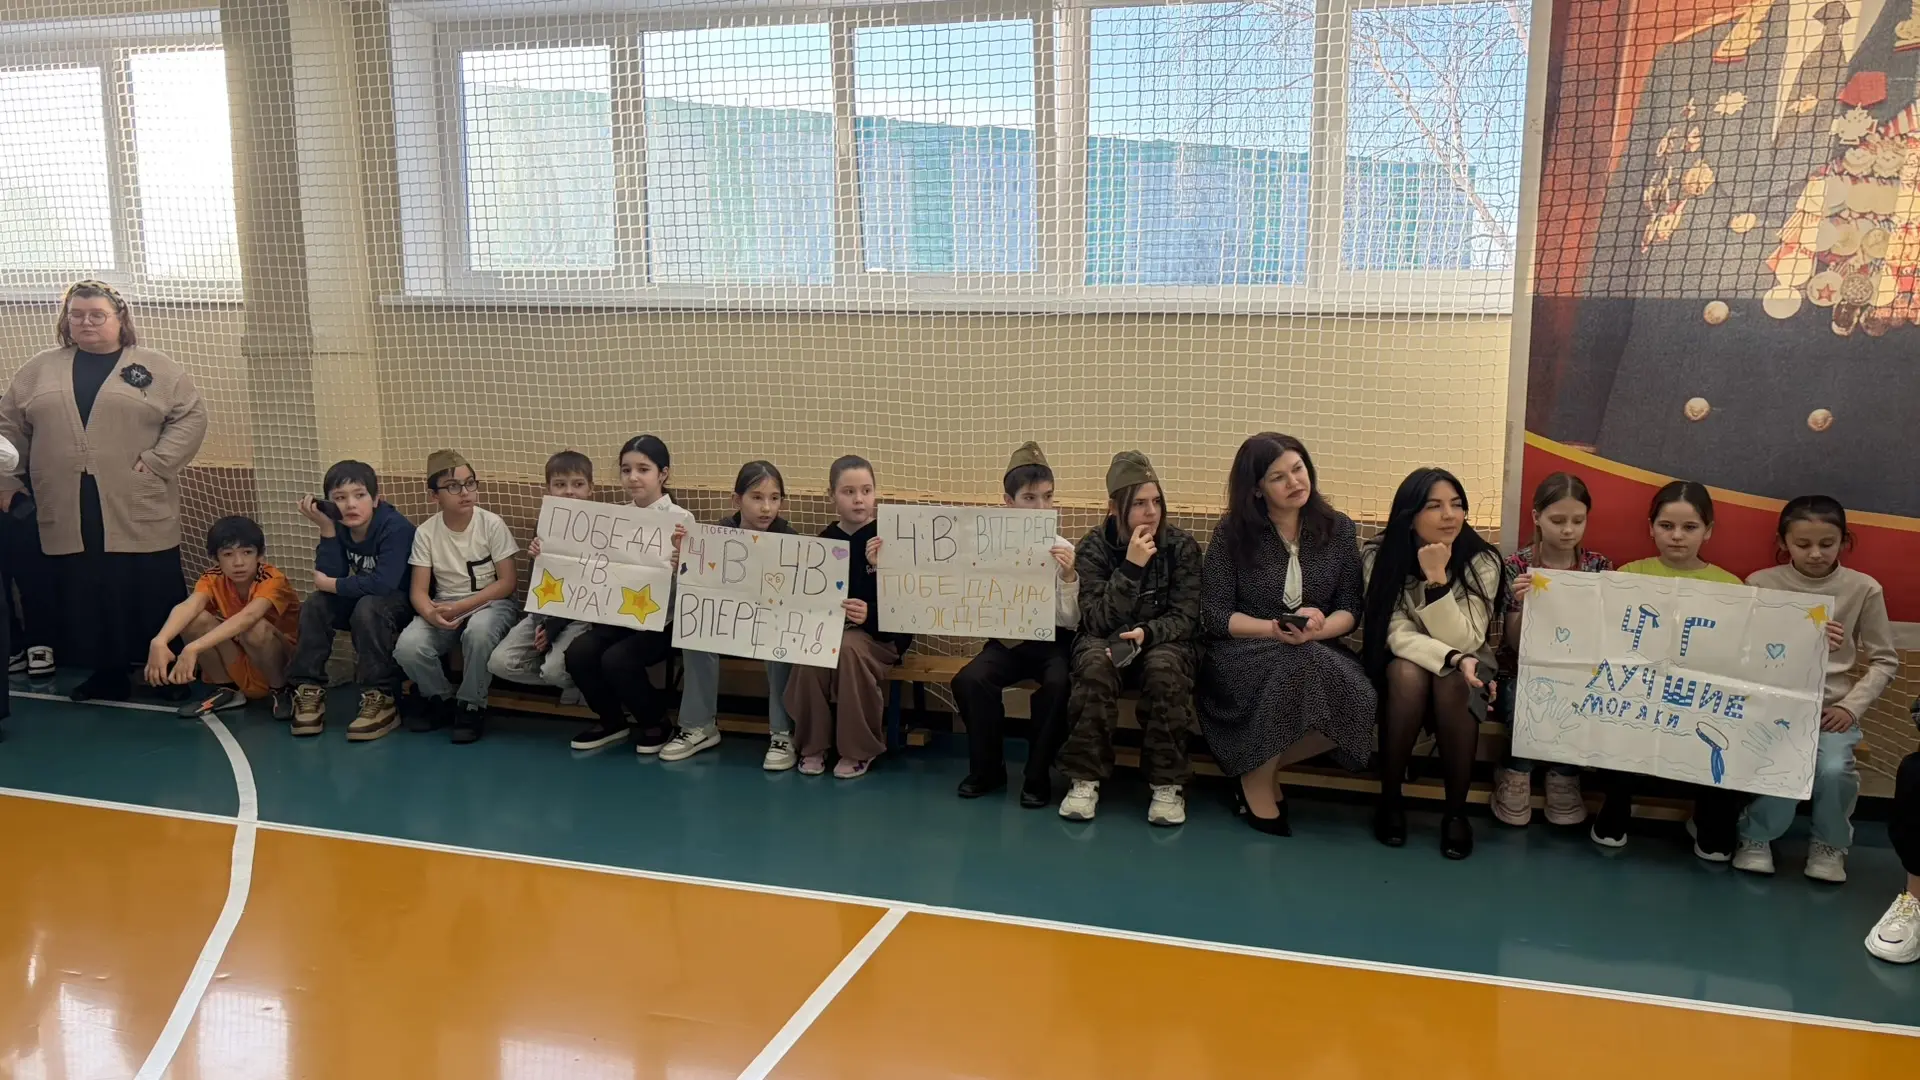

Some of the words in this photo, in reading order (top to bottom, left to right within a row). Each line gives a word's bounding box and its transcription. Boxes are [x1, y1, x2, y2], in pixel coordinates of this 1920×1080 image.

[549, 507, 662, 556] ПОБЕДА
[567, 583, 613, 617] УРА!
[1585, 659, 1746, 719] ЛУЧШИЕ
[1580, 693, 1680, 728] МОРЯКИ
